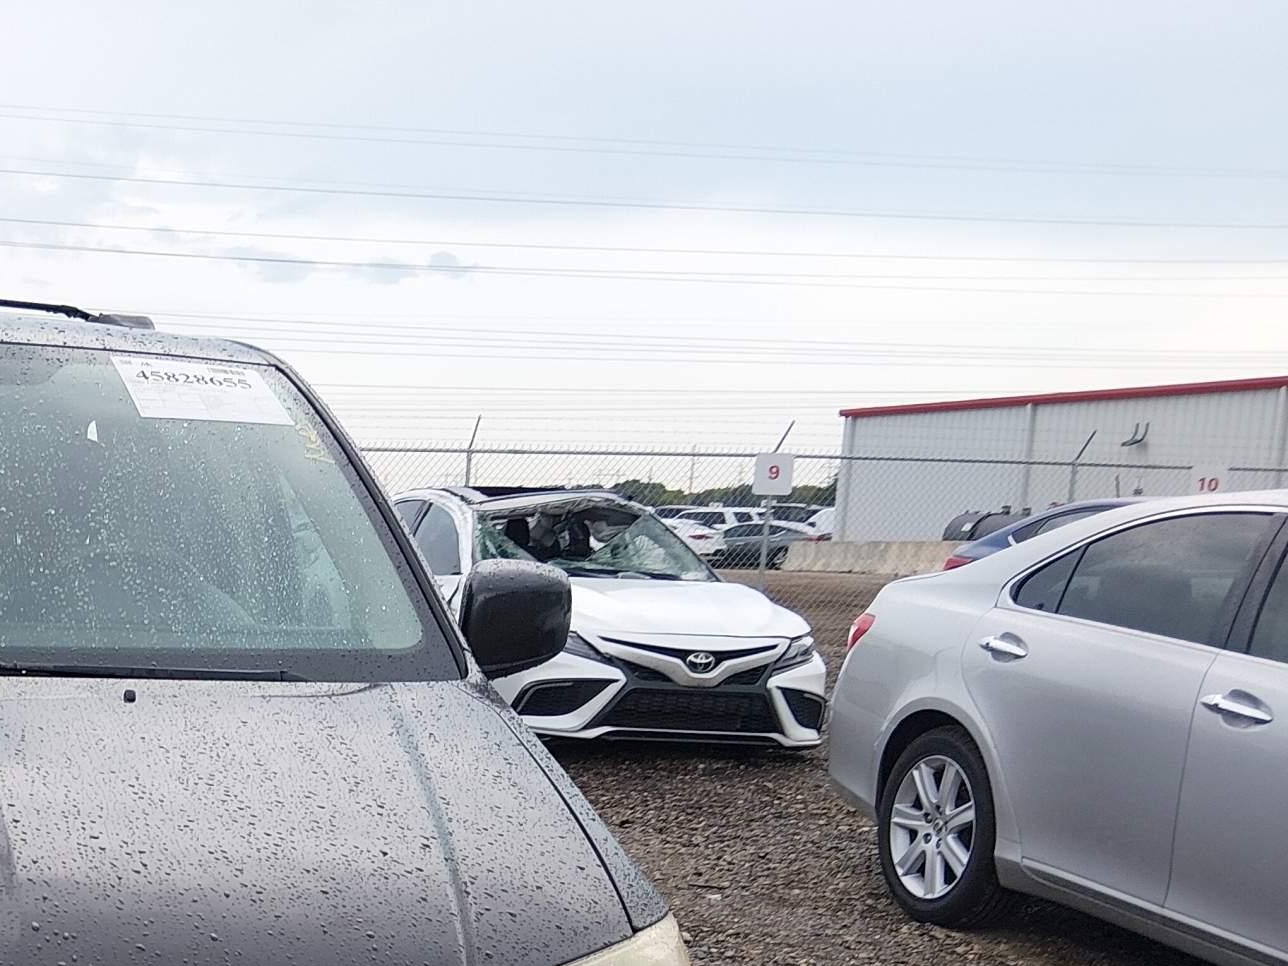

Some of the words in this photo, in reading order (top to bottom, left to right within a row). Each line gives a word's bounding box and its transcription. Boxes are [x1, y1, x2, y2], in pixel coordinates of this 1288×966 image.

[136, 369, 252, 389] 45828655
[768, 464, 780, 480] 9
[1198, 477, 1218, 492] 10
